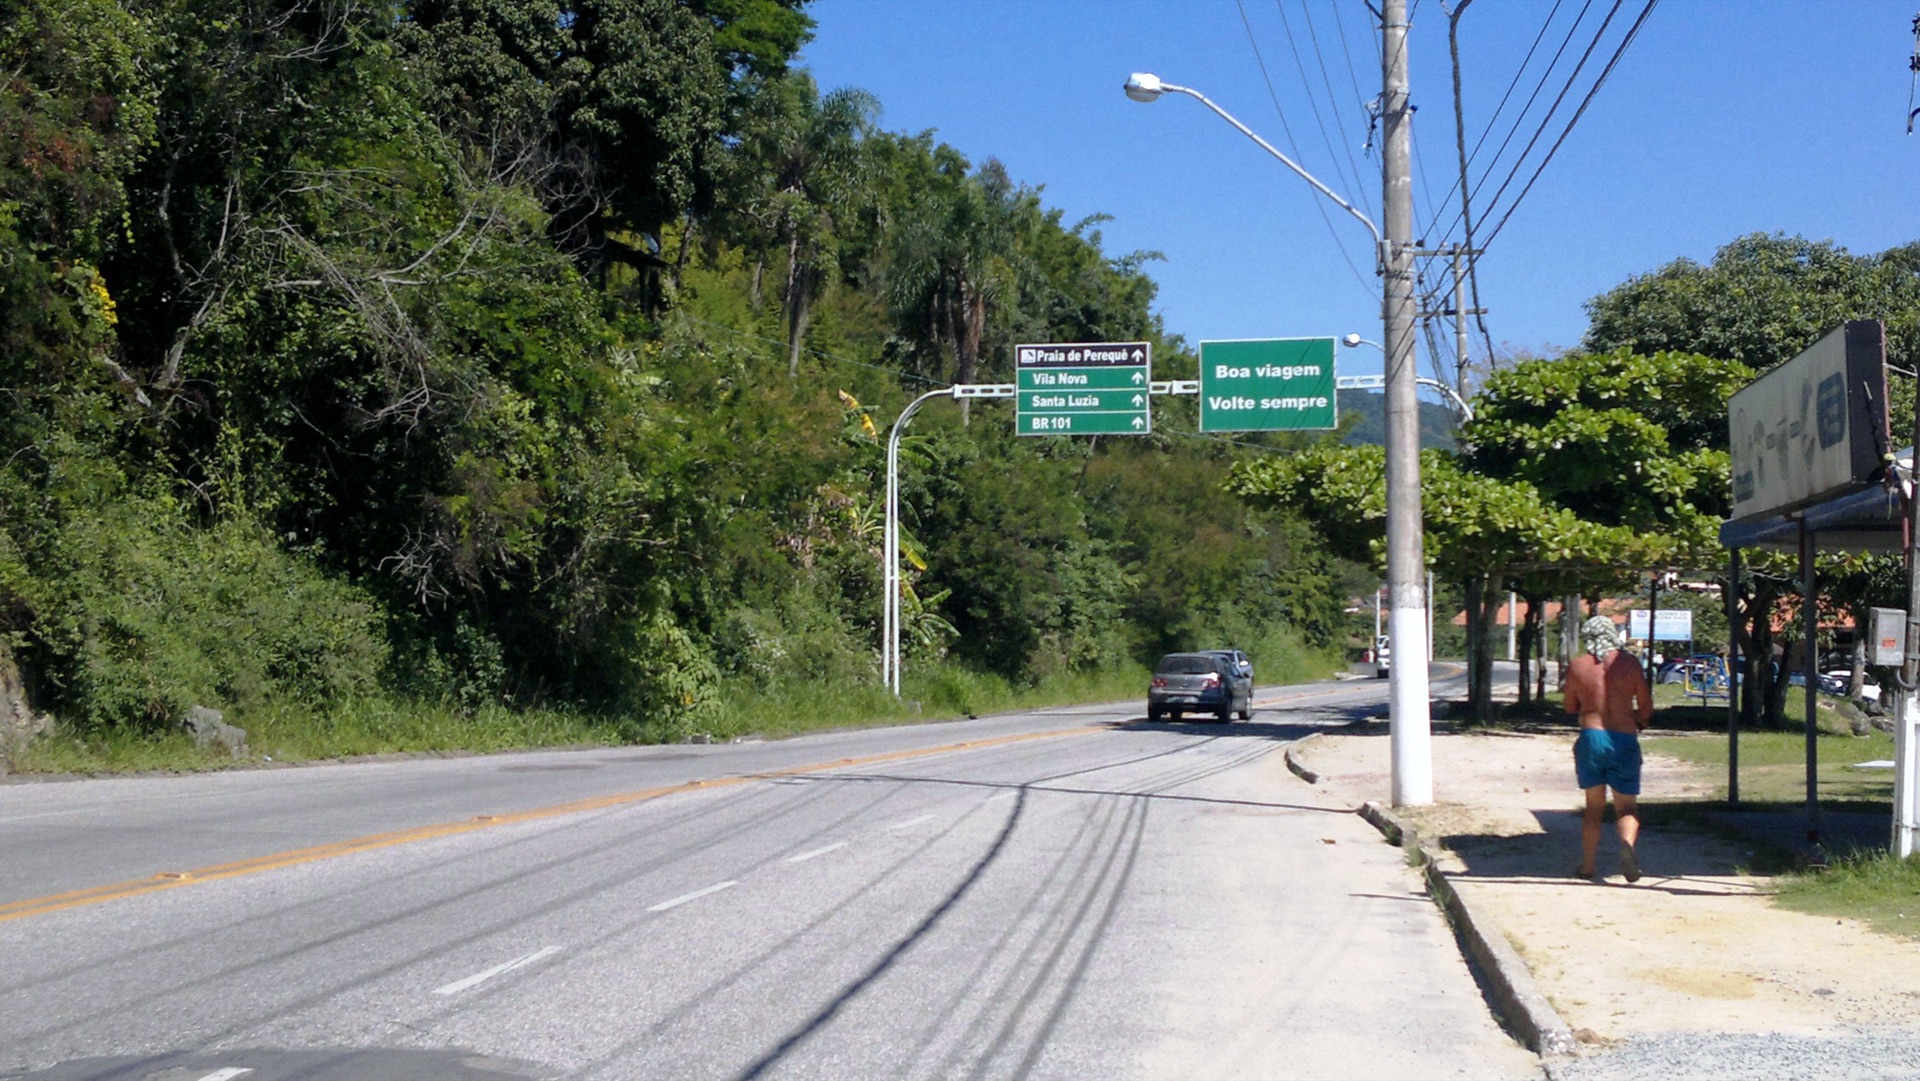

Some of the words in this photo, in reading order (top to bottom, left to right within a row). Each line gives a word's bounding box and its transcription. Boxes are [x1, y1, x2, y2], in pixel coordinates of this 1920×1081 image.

[1037, 350, 1065, 363] Praia
[1067, 350, 1081, 362] de
[1083, 348, 1128, 363] Perequê
[1033, 373, 1055, 385] Vila
[1058, 372, 1088, 384] Nova
[1215, 365, 1250, 379] Boa
[1255, 364, 1320, 380] viagem
[1032, 395, 1065, 407] Santa
[1068, 394, 1099, 406] Luzia
[1208, 396, 1256, 410] Volte
[1260, 396, 1328, 411] sempre
[1032, 417, 1049, 429] BR
[1051, 417, 1071, 429] 101
